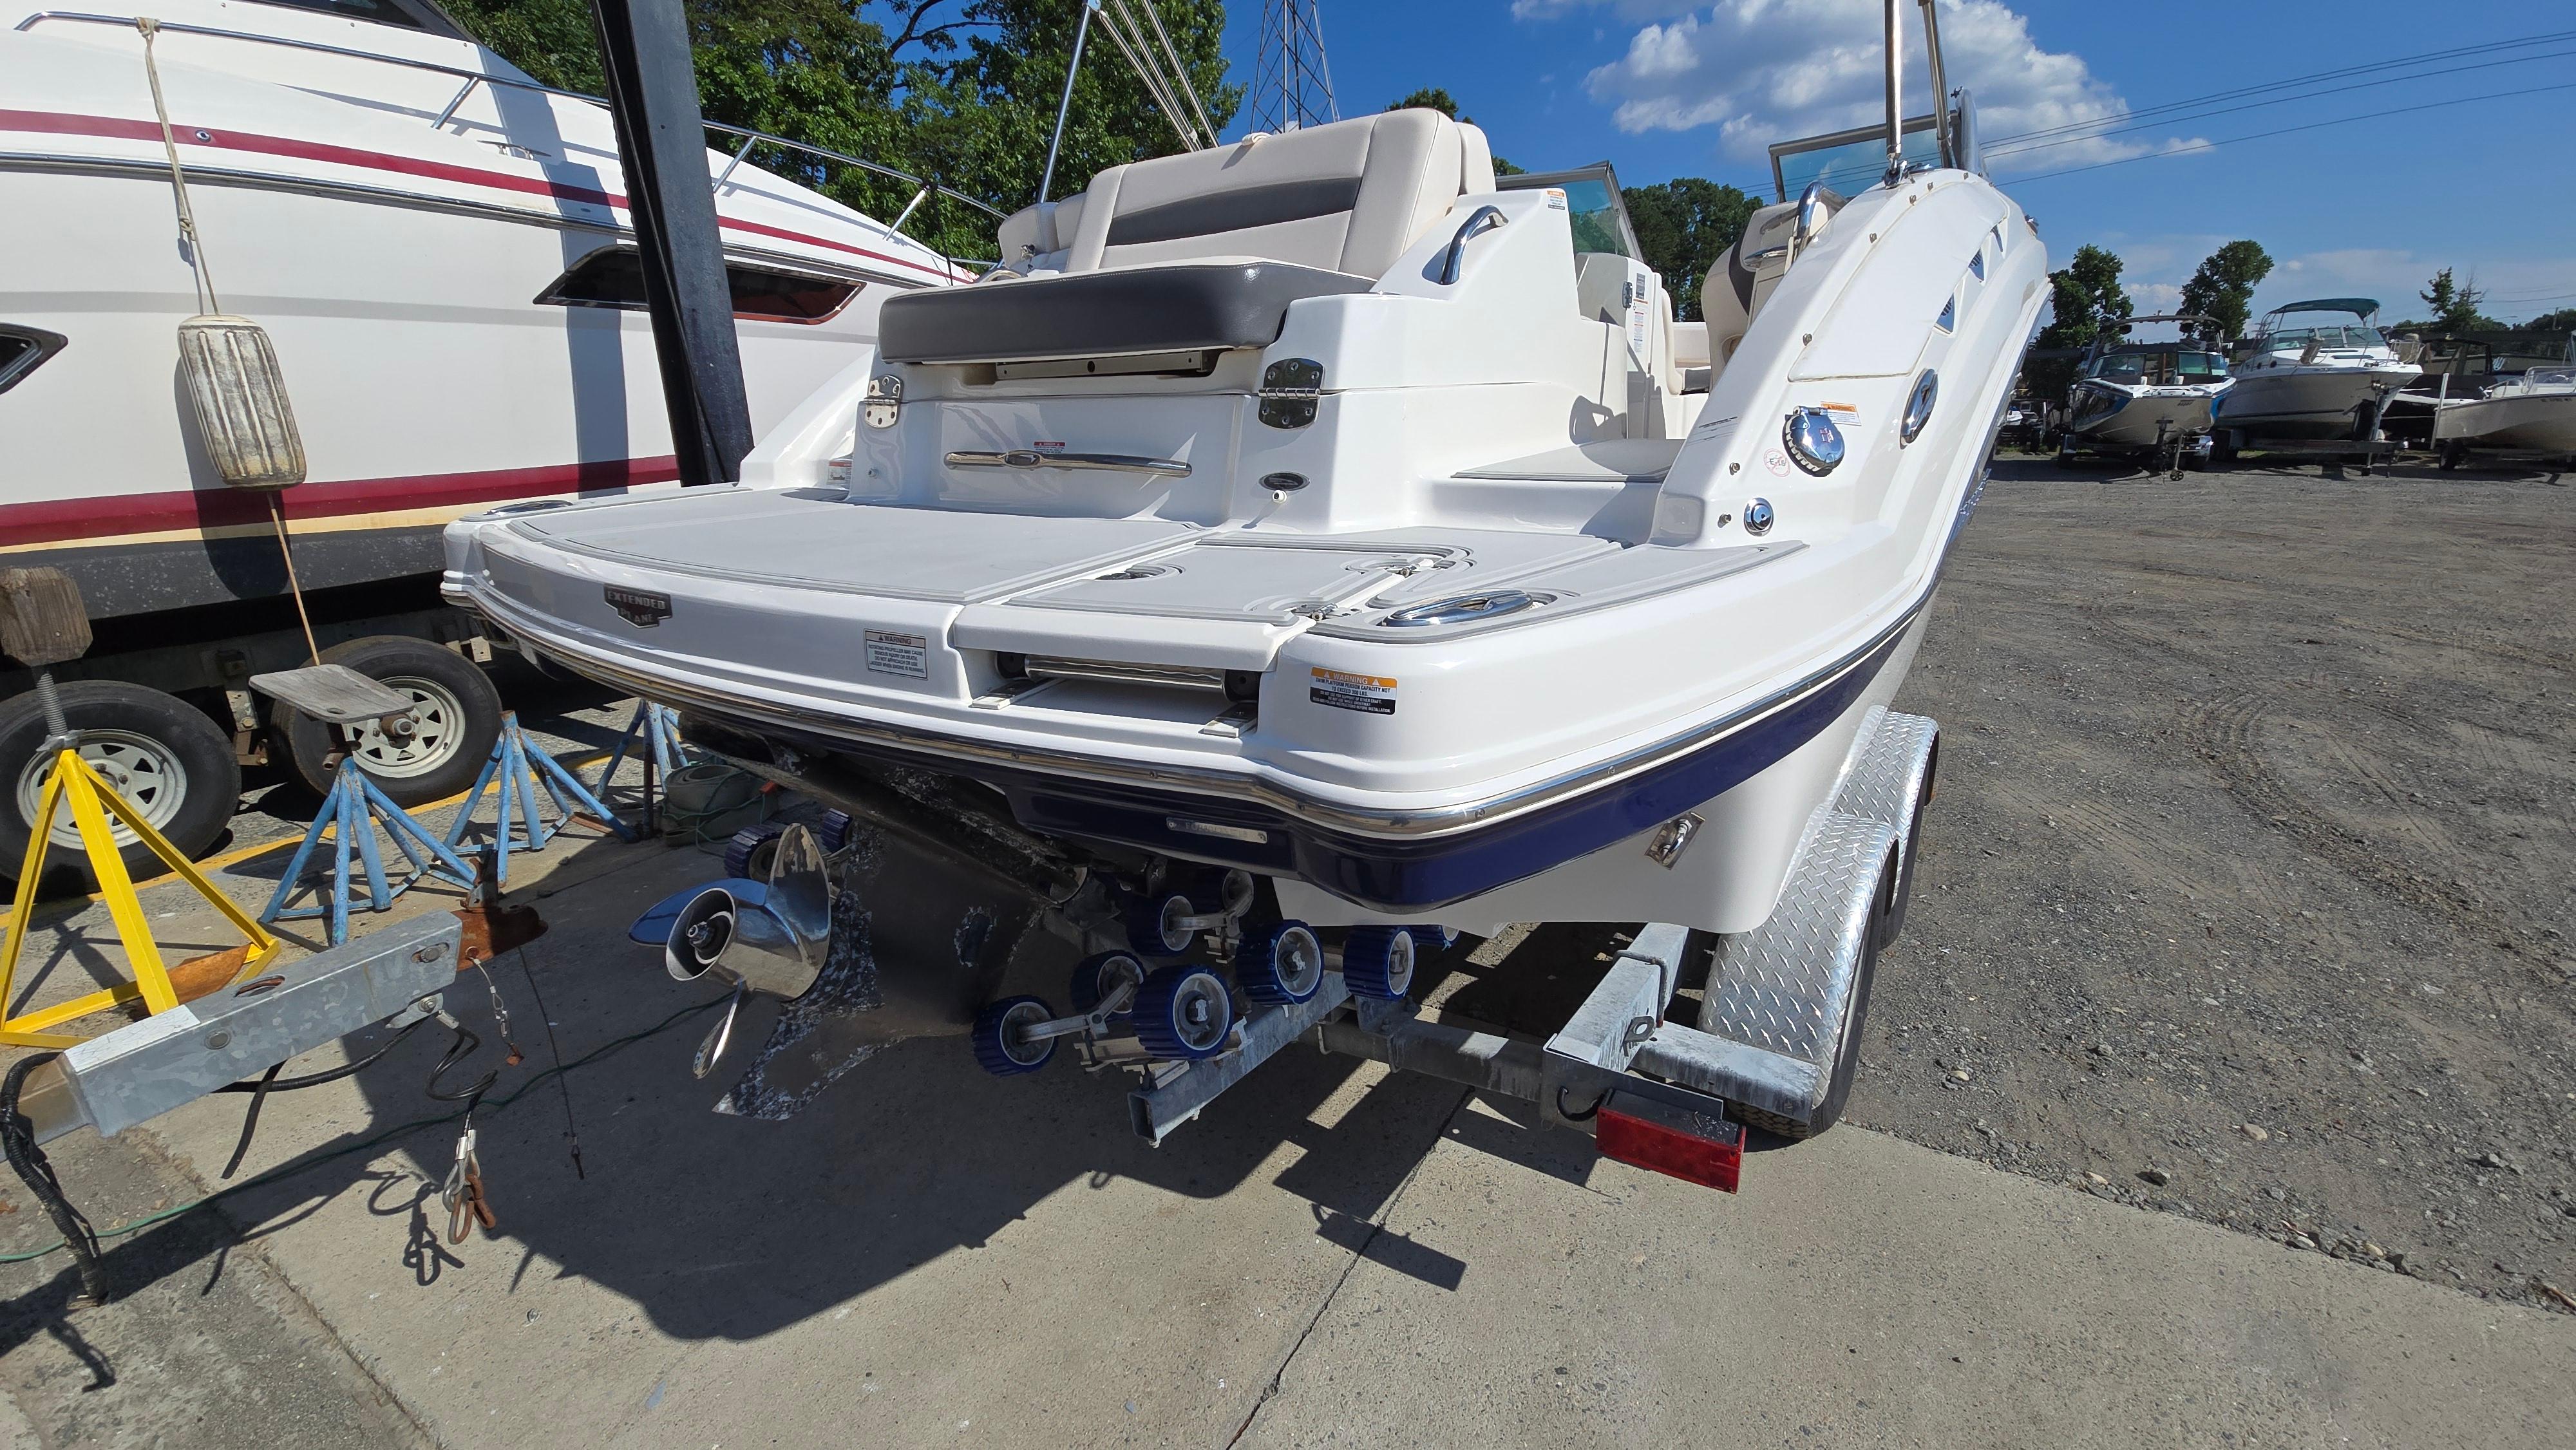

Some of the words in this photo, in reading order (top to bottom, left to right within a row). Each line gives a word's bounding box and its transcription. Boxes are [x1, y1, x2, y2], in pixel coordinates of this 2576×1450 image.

[607, 591, 666, 610] EXTENDED
[620, 607, 654, 623] PLANE
[884, 635, 911, 645] WARNING
[1333, 672, 1368, 684] WARNING
